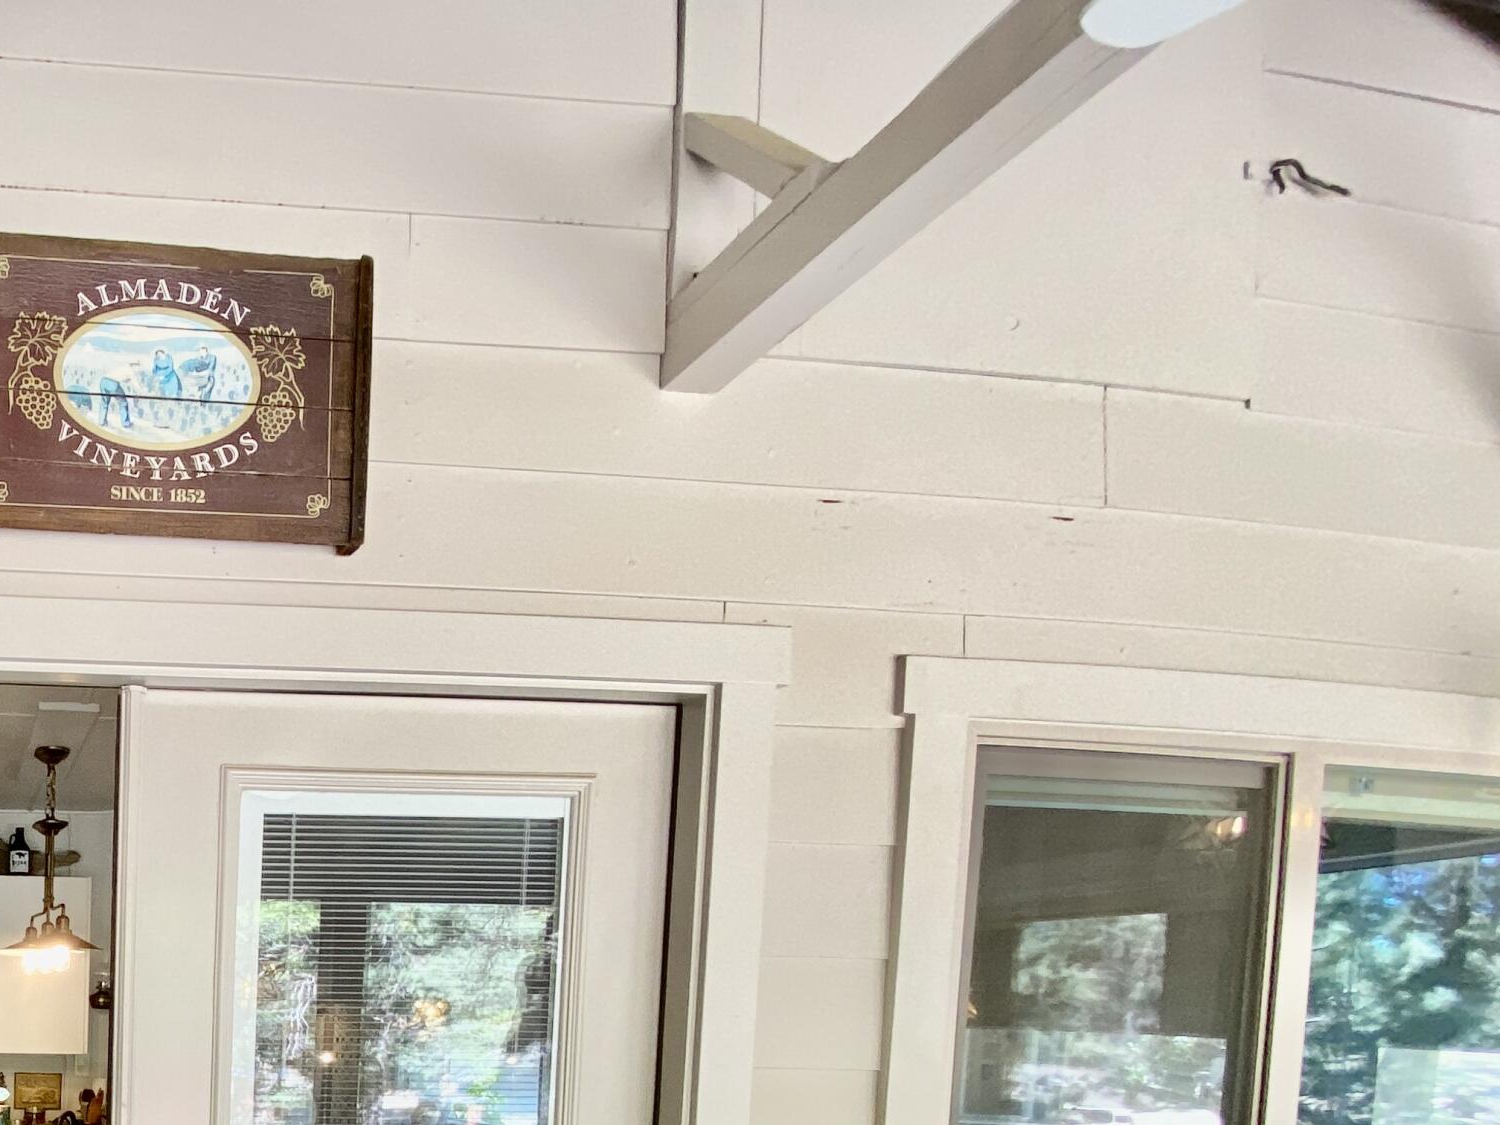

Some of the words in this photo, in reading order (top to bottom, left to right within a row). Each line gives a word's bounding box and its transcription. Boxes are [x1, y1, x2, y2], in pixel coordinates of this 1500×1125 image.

[75, 278, 251, 326] ALMADÉN
[58, 420, 259, 481] VINEYARDS
[110, 485, 164, 503] SINCE
[169, 488, 207, 504] 1852
